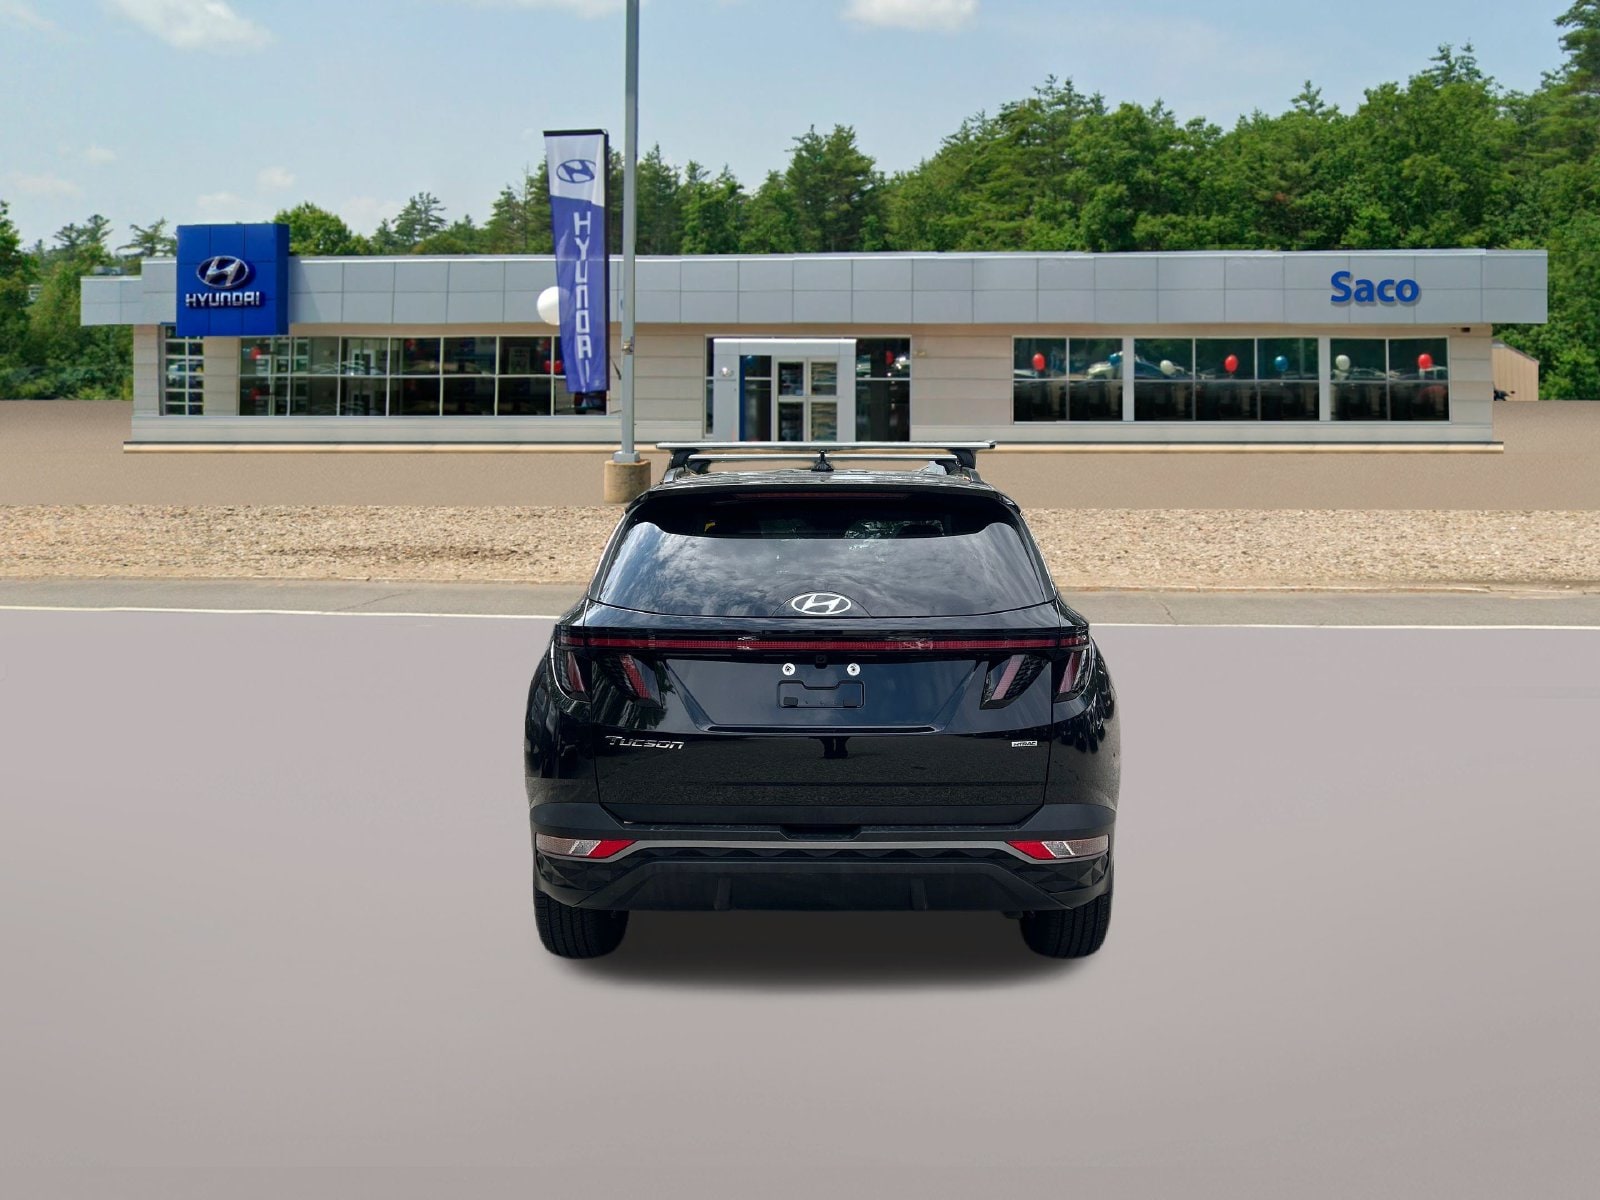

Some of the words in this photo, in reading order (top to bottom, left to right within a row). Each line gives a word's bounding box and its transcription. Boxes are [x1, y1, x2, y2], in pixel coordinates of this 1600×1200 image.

[185, 291, 260, 307] HYUNDAI
[573, 211, 592, 382] HYUNDAI
[1331, 270, 1420, 303] Saco
